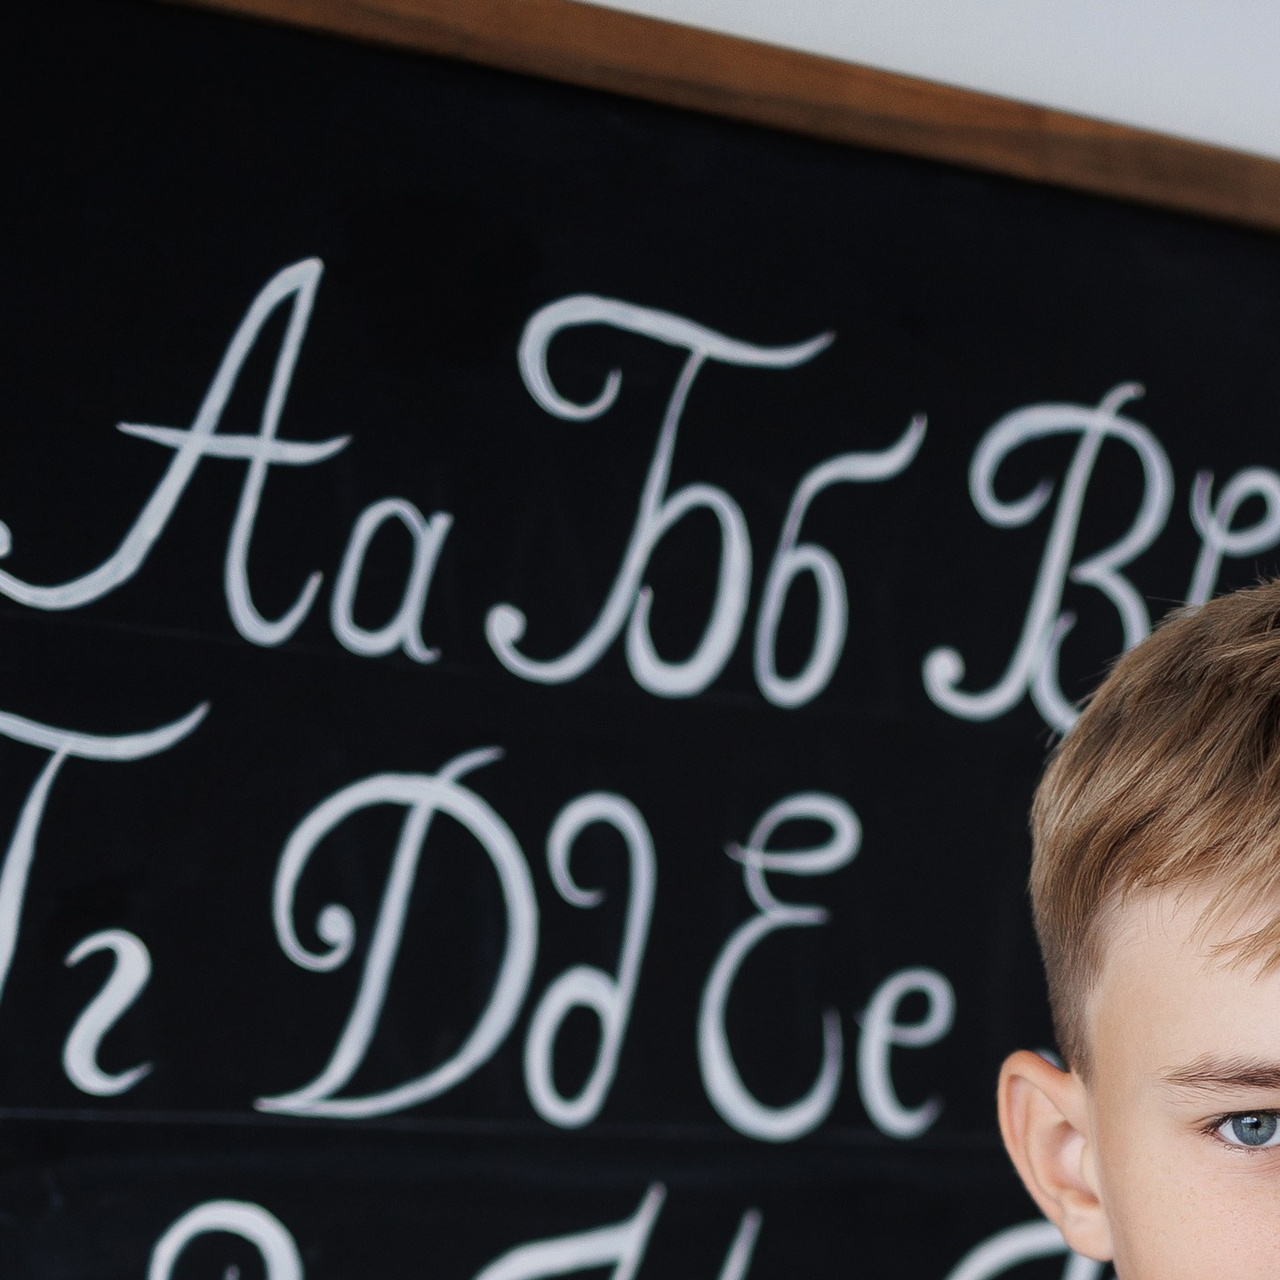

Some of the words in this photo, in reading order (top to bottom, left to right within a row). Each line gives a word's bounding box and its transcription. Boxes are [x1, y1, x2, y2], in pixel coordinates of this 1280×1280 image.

[0, 256, 454, 664] Аа
[485, 293, 928, 708] Бб
[253, 746, 658, 1130] Дд
[696, 791, 956, 1142] Ее
